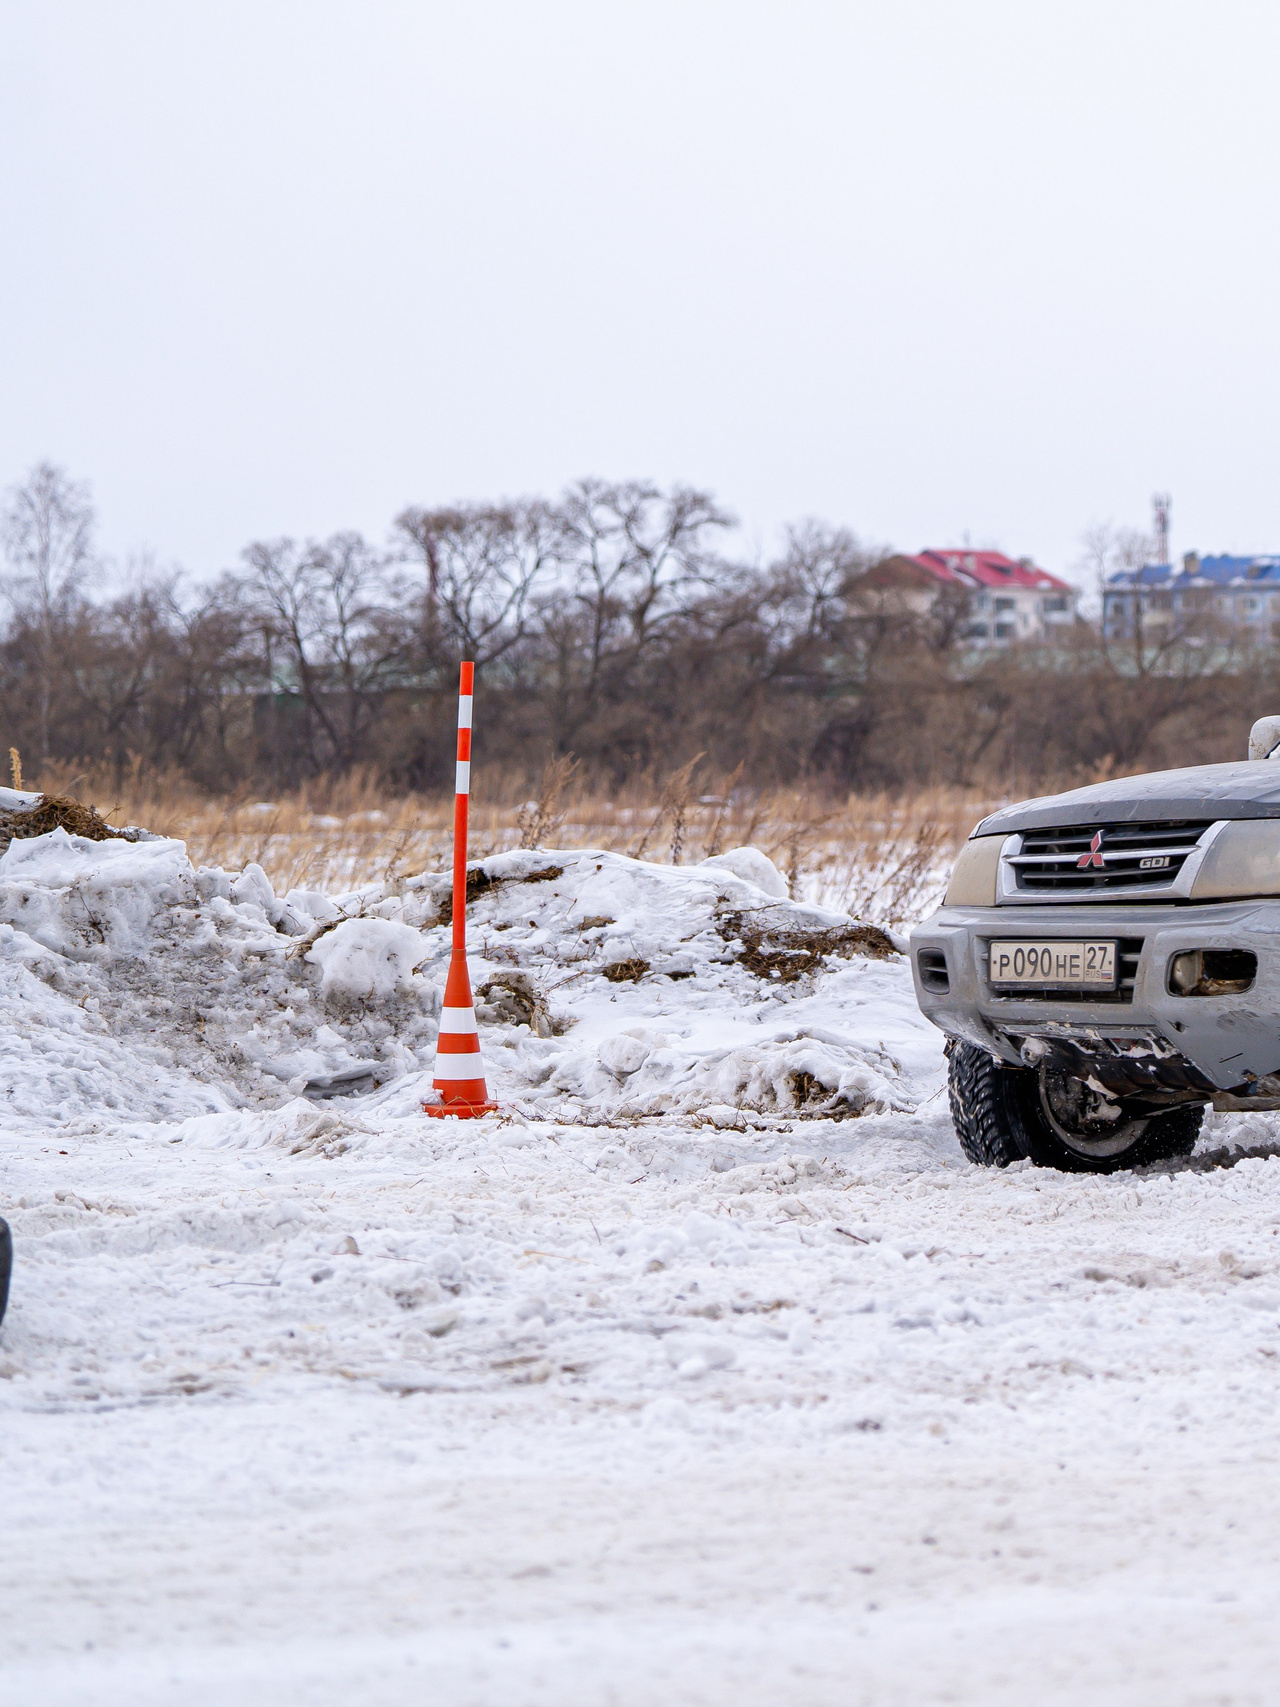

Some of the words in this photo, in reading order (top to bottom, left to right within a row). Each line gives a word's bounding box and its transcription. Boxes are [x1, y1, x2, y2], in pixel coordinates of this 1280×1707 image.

[1139, 856, 1171, 869] GDI
[1086, 946, 1108, 970] 27
[1085, 970, 1101, 979] RUS
